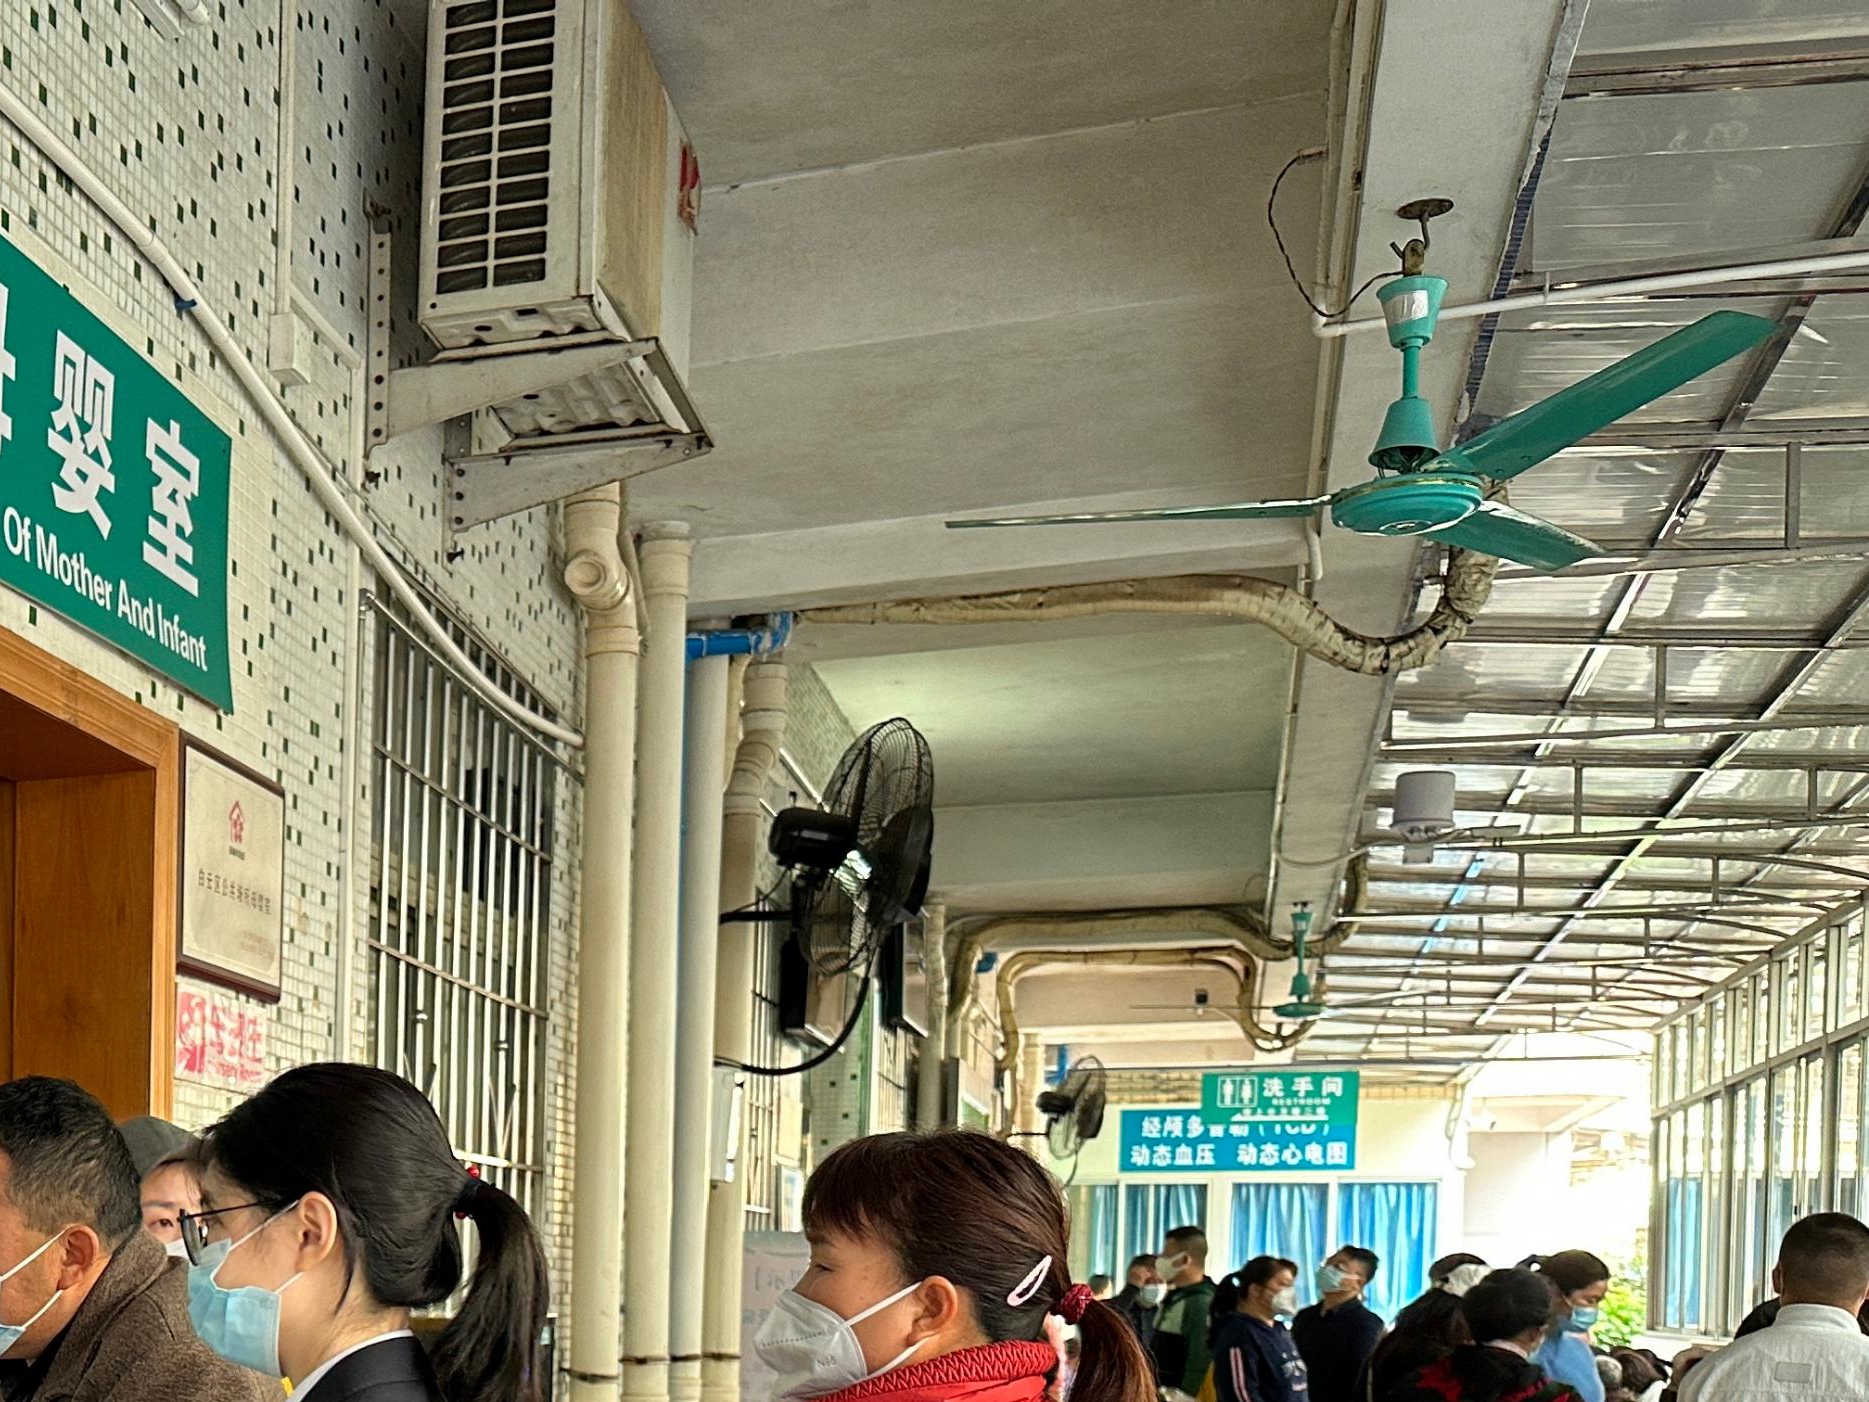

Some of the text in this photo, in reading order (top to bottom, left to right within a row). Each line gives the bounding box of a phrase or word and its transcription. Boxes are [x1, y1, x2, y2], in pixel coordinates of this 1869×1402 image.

[3, 505, 31, 563] Of
[34, 522, 113, 611] Mother
[117, 578, 155, 640] And
[157, 603, 208, 672] Infant
[1262, 1076, 1344, 1098] 洗手间
[1130, 1141, 1348, 1167] 动态血压 动态心电图
